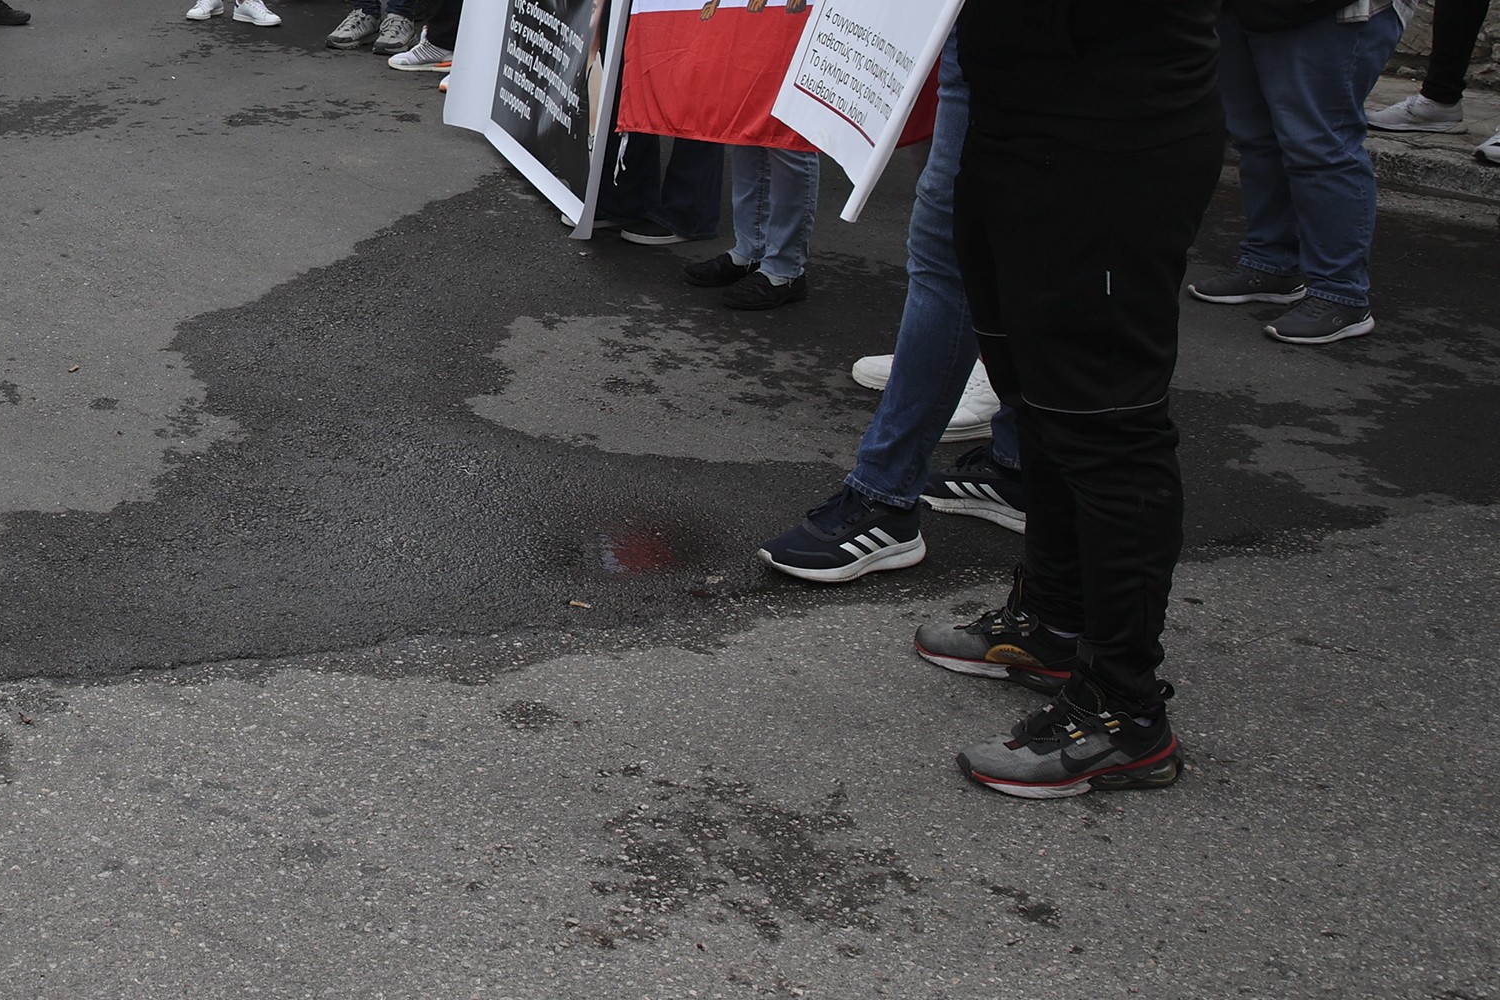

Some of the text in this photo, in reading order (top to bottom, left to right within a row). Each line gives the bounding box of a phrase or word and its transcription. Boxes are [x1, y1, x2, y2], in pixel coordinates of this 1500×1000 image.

[511, 14, 523, 34] δεν
[522, 26, 553, 54] εγκρίθηκε
[825, 7, 833, 21] 4
[832, 13, 873, 47] συγγραφείς
[816, 31, 853, 63] καθεστώς
[852, 50, 865, 71] της
[503, 64, 514, 80] και
[513, 69, 535, 96] πέθανε
[800, 73, 836, 104] ελευθερία
[836, 95, 849, 113] του
[809, 48, 821, 67] Το
[820, 56, 850, 85] έγκλημα
[850, 76, 866, 99] τους
